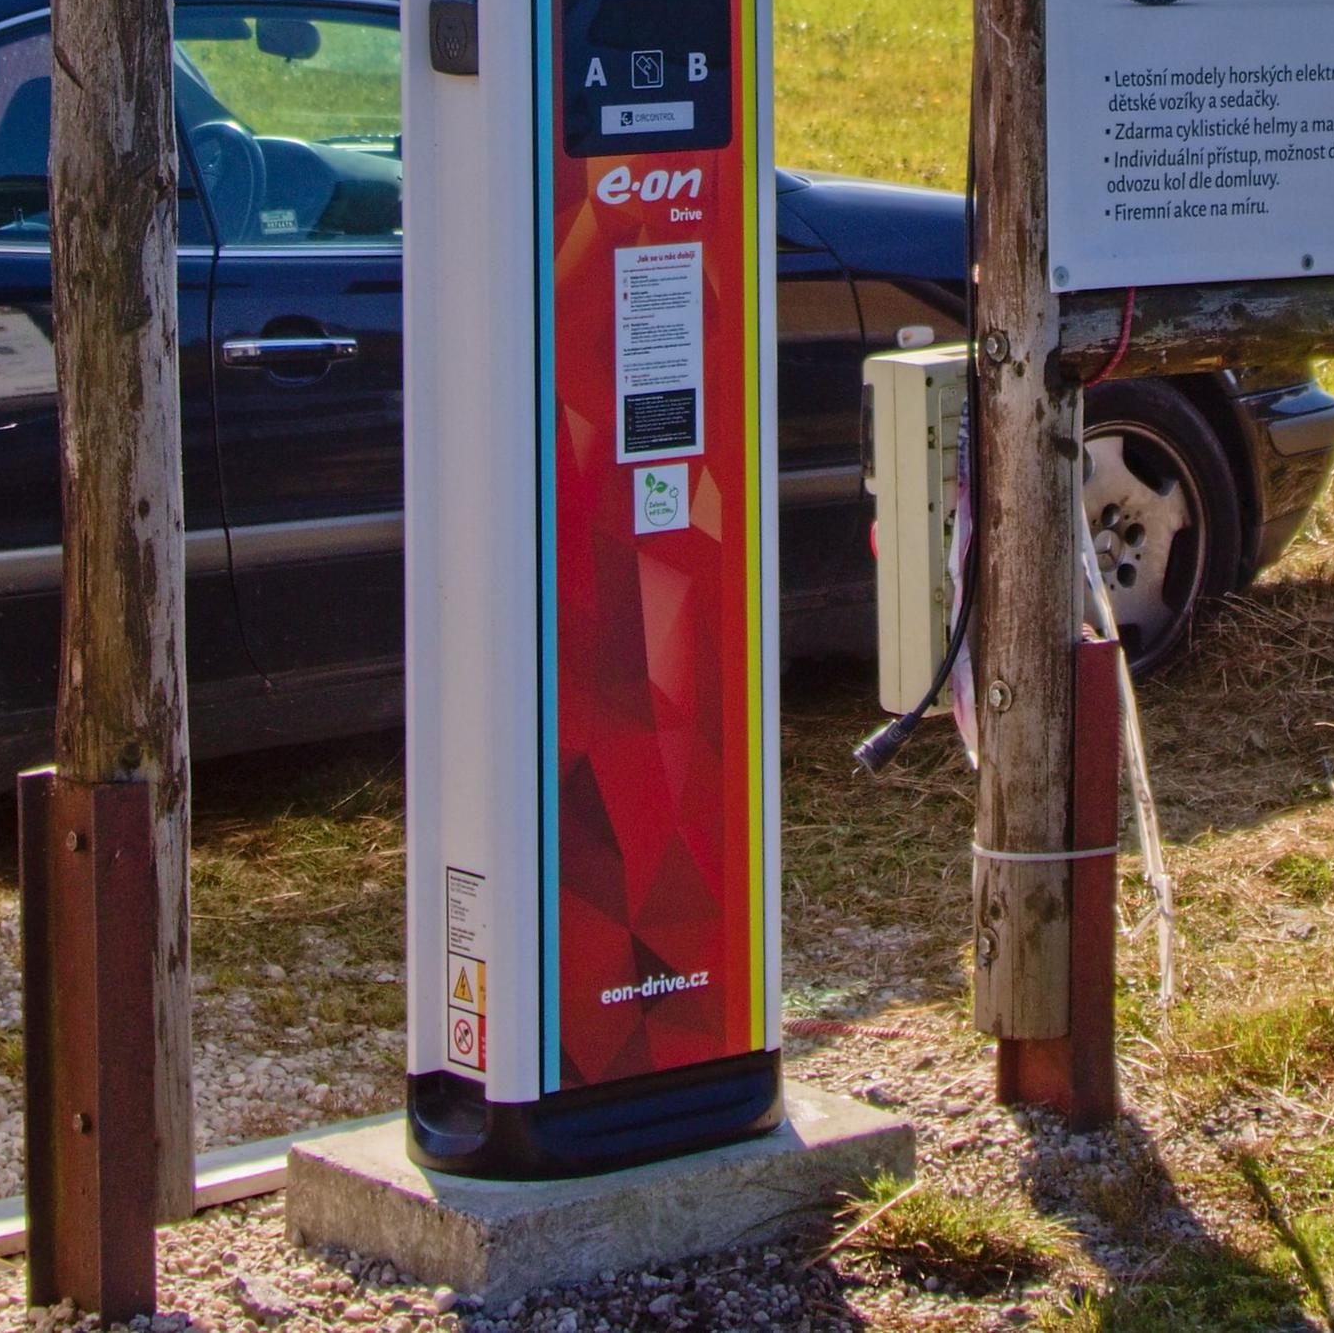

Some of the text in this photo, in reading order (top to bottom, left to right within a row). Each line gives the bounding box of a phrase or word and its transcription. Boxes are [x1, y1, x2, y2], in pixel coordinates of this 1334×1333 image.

[585, 57, 607, 87] A
[688, 52, 709, 82] B
[1115, 68, 1168, 87] Letošní
[1171, 67, 1226, 88] modely
[1229, 64, 1293, 86] horských
[1108, 89, 1280, 114] dětské vozíky a sedačky.
[1115, 121, 1173, 140] Zdarma
[1176, 117, 1250, 142] cyklistické
[1253, 116, 1298, 138] helmy
[1300, 119, 1309, 133] a
[1114, 147, 1205, 168] Individuální
[1207, 146, 1261, 169] přístup,
[1264, 143, 1327, 162] možnost
[1107, 168, 1280, 193] odvozu kol dle domluvy.
[670, 208, 703, 223] Drive
[1114, 197, 1269, 221] Firemní akce na míru.
[601, 971, 709, 1005] eon-drive.cz
